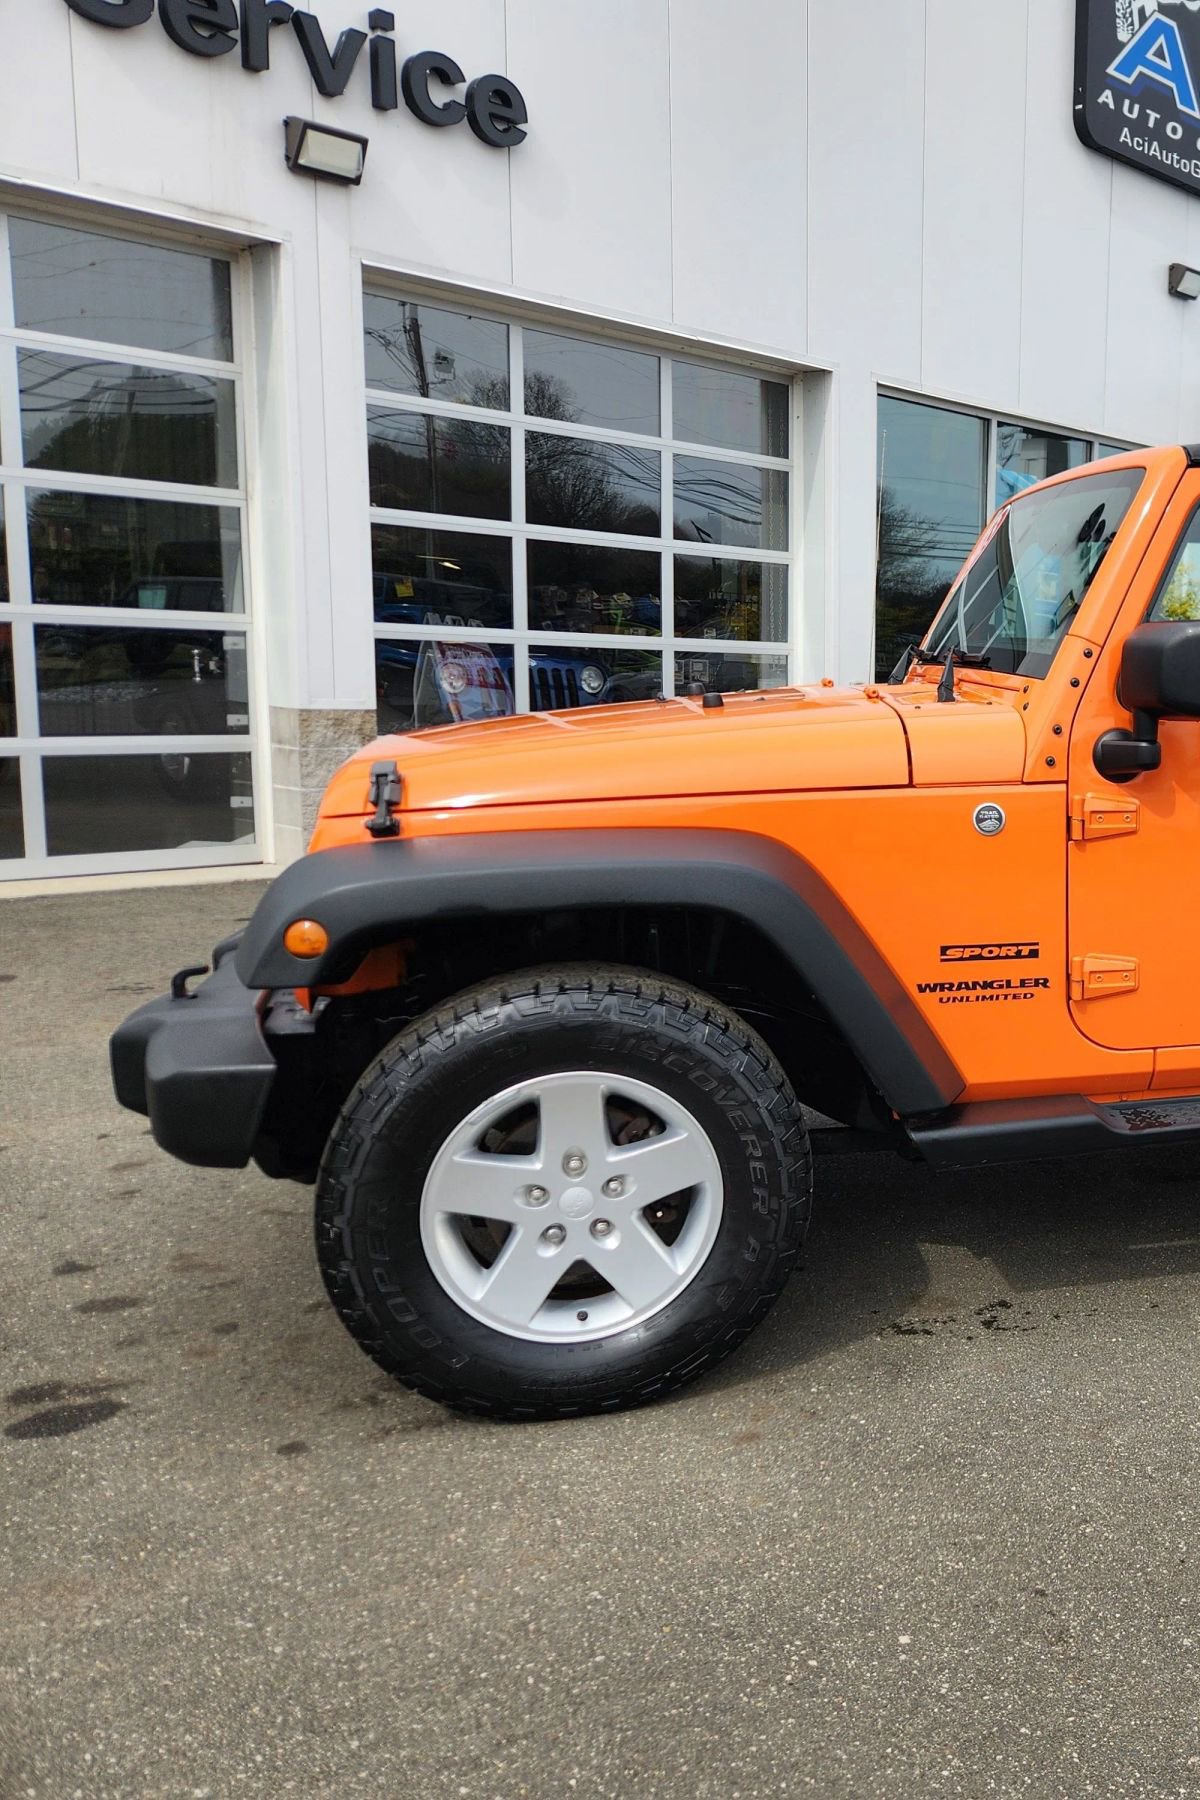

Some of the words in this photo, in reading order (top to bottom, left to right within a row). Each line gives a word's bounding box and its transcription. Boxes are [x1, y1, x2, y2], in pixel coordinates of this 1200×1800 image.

[1097, 88, 1183, 140] AUTO
[941, 946, 1038, 960] SPORT
[916, 977, 1050, 994] WRANGLER
[938, 992, 1035, 1004] UNLIMITED
